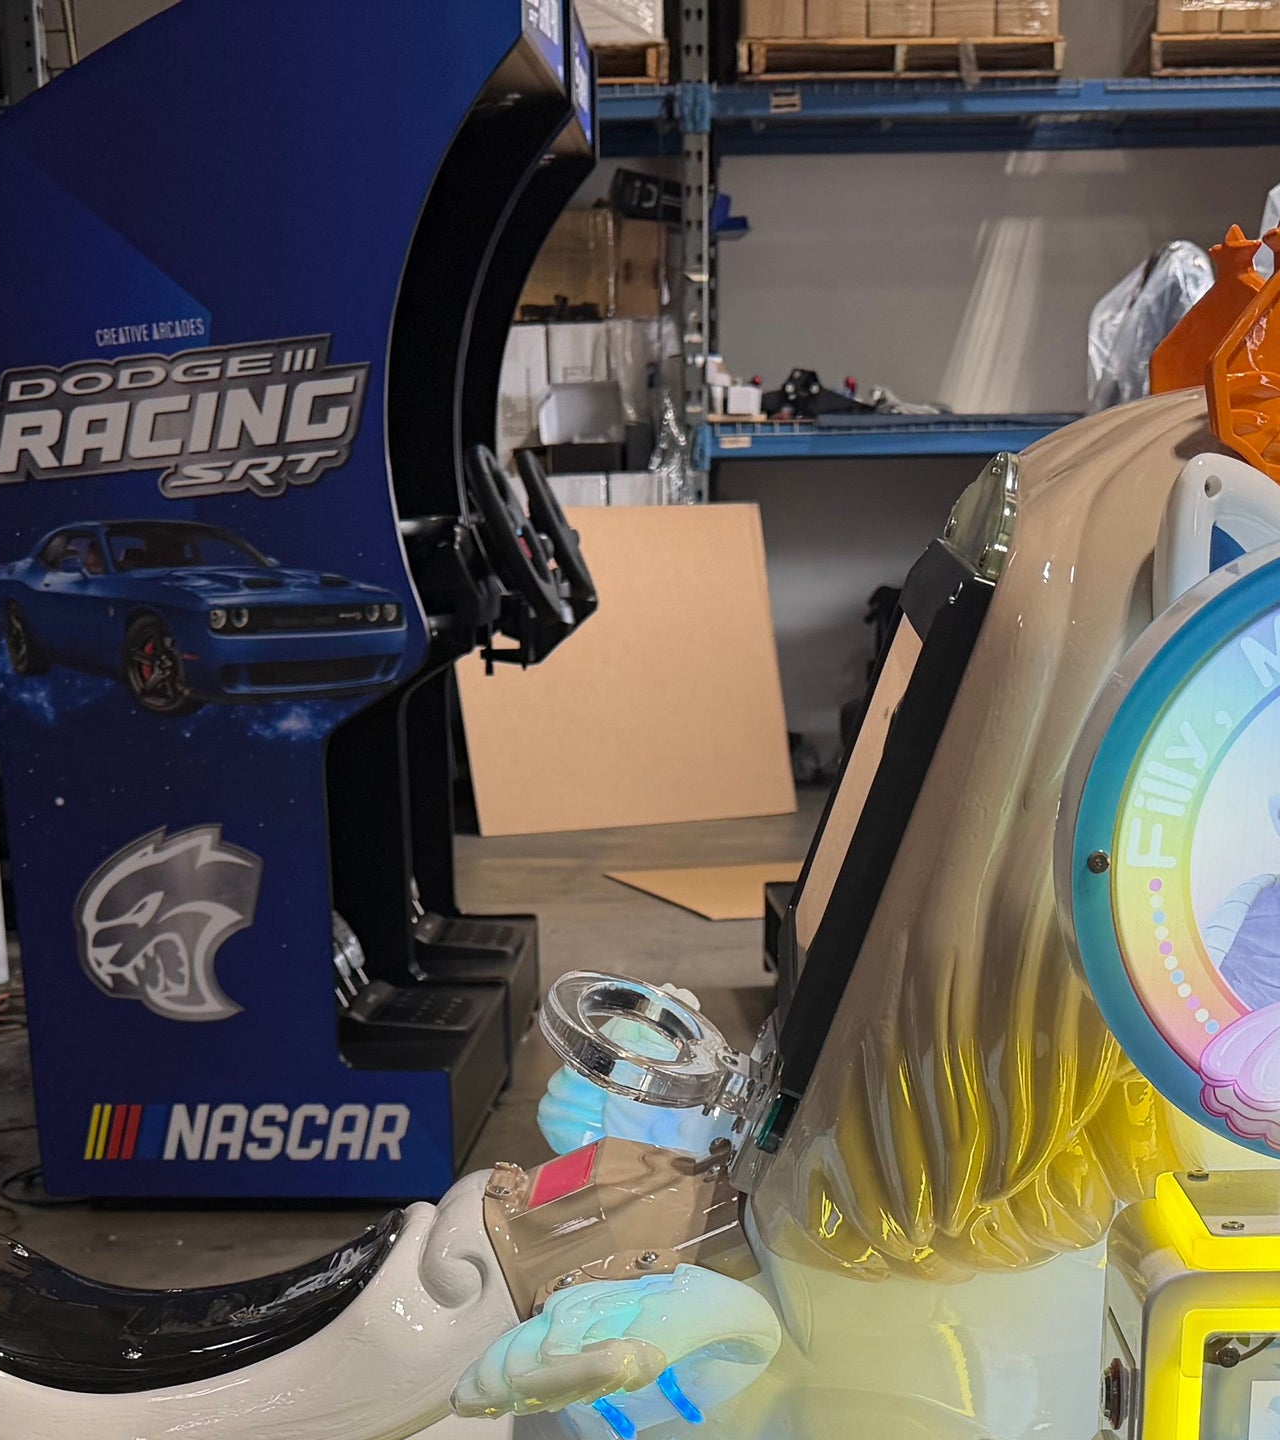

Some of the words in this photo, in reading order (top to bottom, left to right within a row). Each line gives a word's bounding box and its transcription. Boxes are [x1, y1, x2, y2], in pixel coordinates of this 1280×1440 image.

[96, 323, 150, 347] CREATIVE
[152, 318, 205, 342] ARCADES
[8, 352, 275, 402] DODGE
[169, 450, 339, 487] SRT
[163, 1103, 411, 1161] NASCAR
